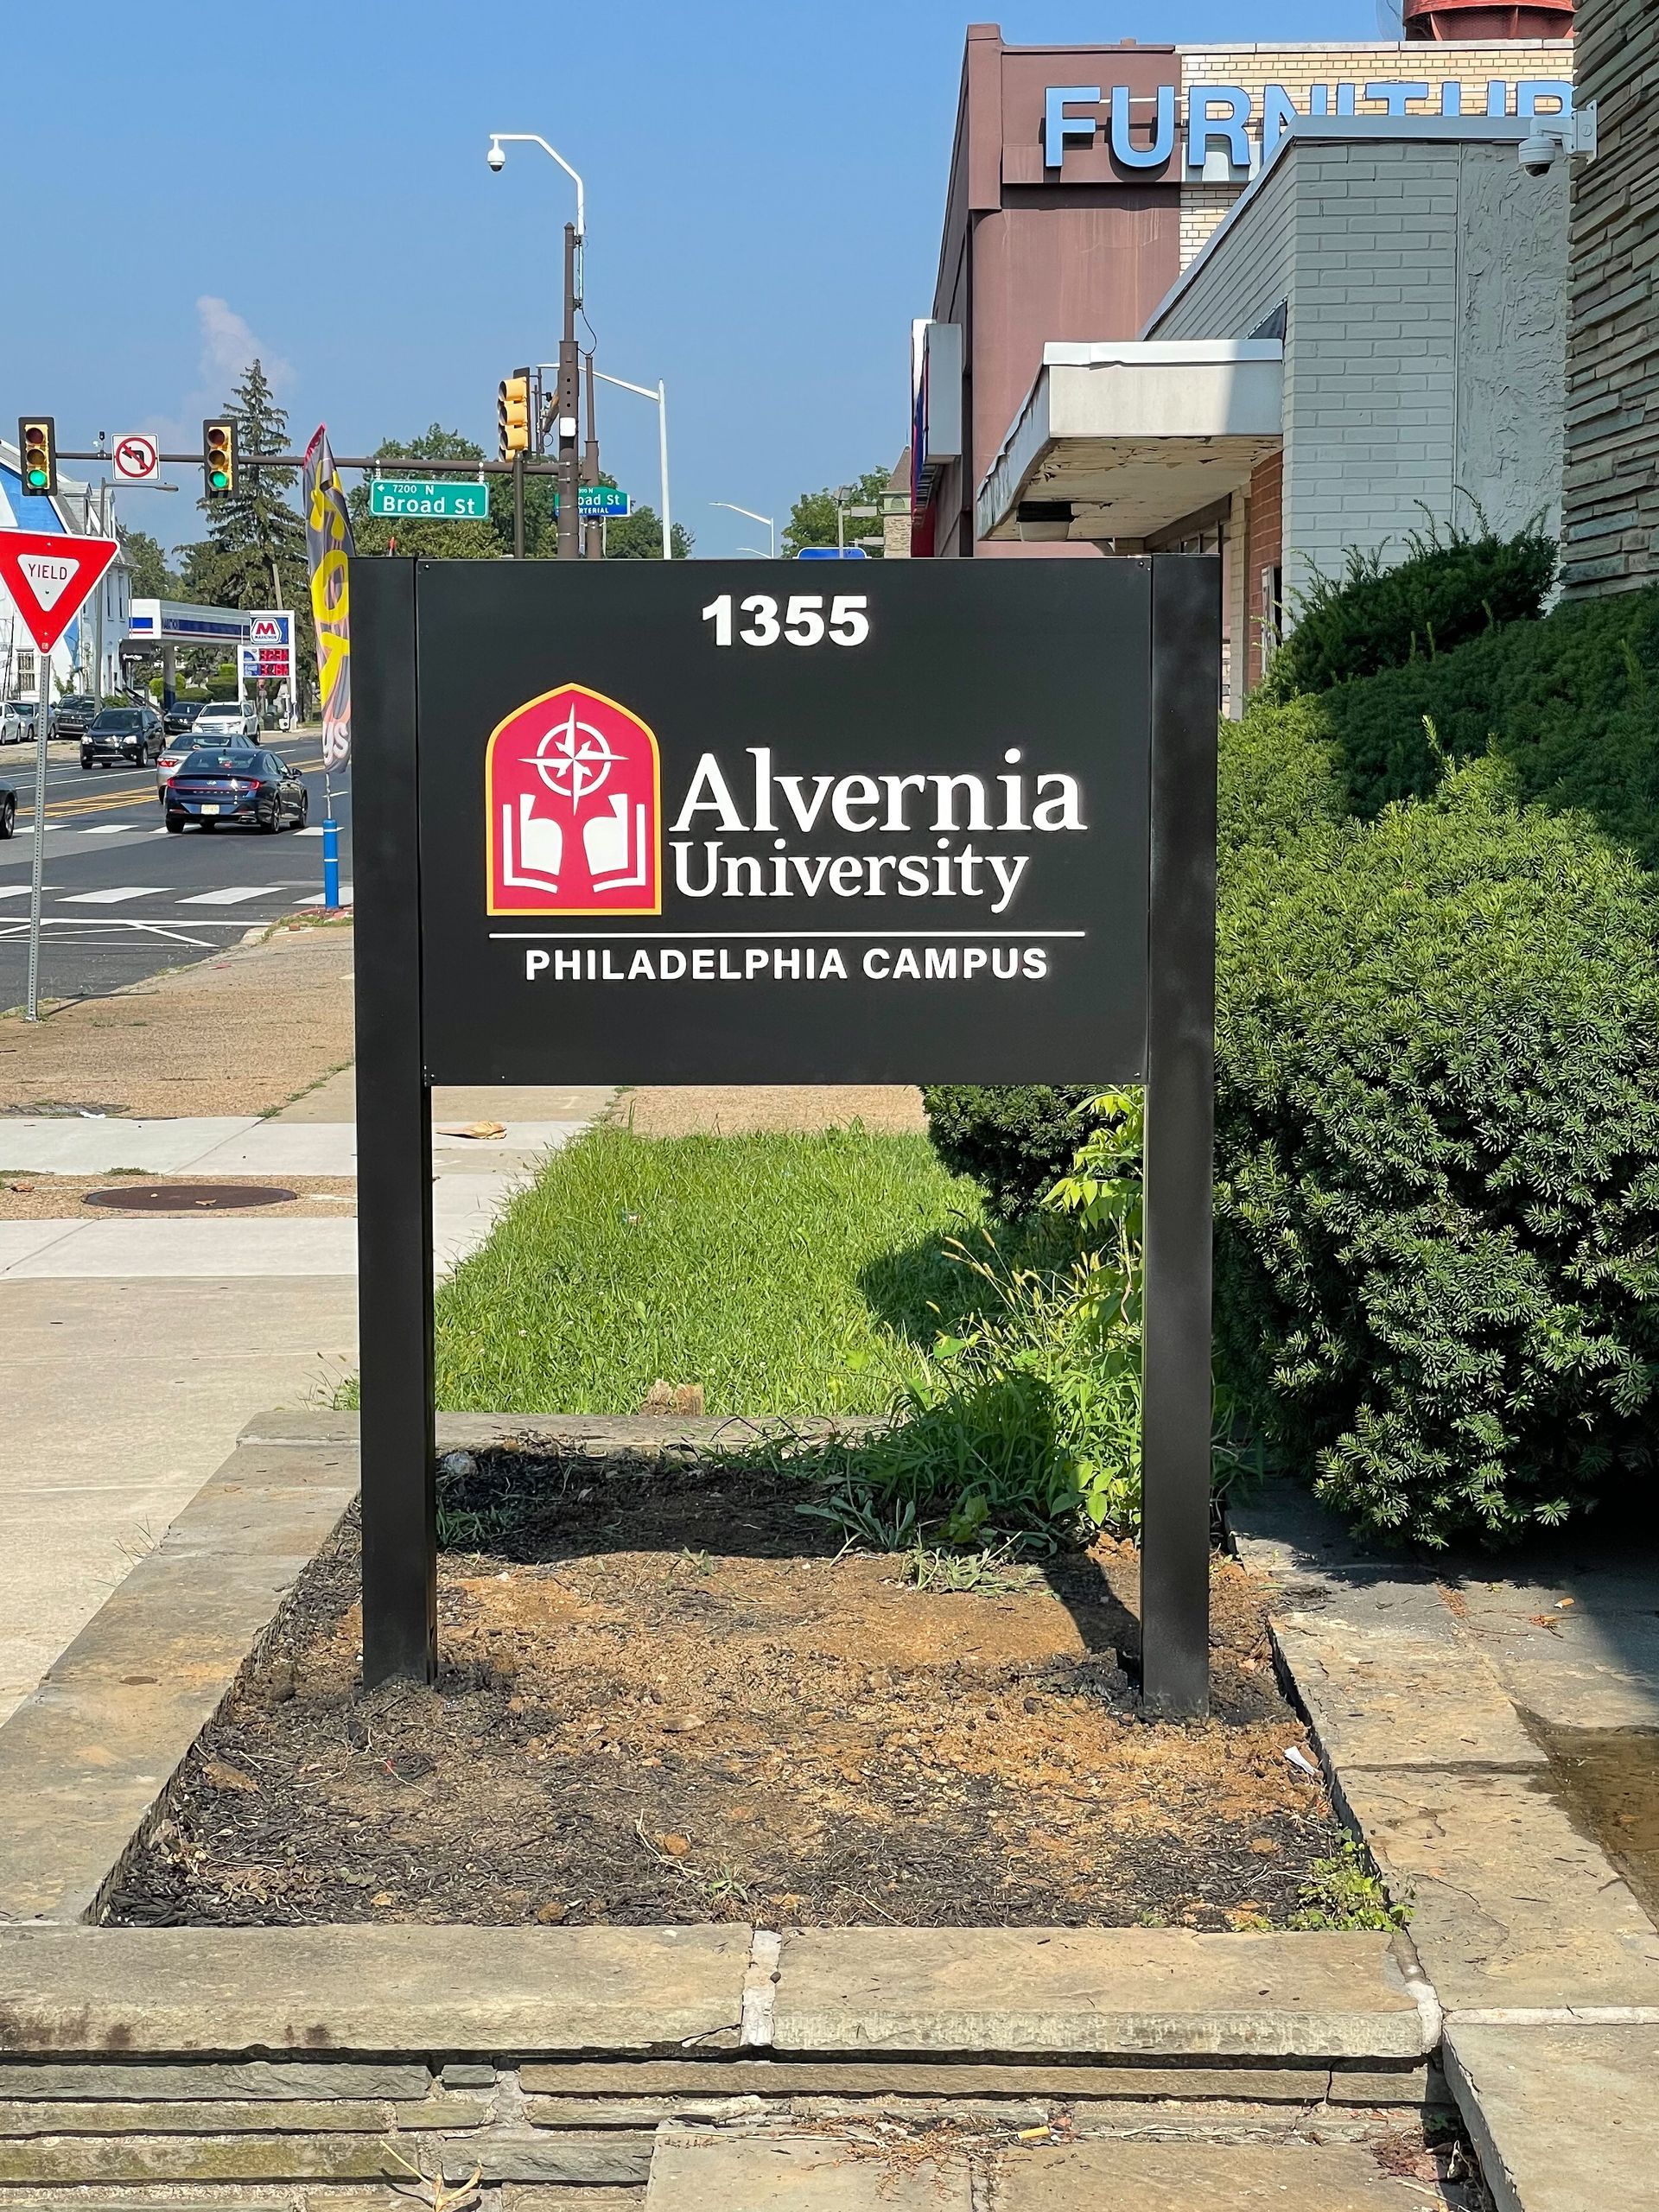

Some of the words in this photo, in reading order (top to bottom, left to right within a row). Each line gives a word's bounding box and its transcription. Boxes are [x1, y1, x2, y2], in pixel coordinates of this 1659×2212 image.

[393, 485, 416, 493] 7200
[425, 485, 434, 495] N
[578, 493, 601, 505] oad
[607, 494, 620, 505] St
[383, 496, 445, 513] Broad
[454, 499, 474, 514] St
[28, 563, 67, 580] YIELD
[256, 622, 276, 634] M
[702, 595, 869, 645] 1355
[669, 747, 1088, 832] Alvernia
[669, 838, 1029, 913] University
[526, 949, 847, 980] PHILADELPHIA
[863, 948, 1046, 979] CAMPUS
